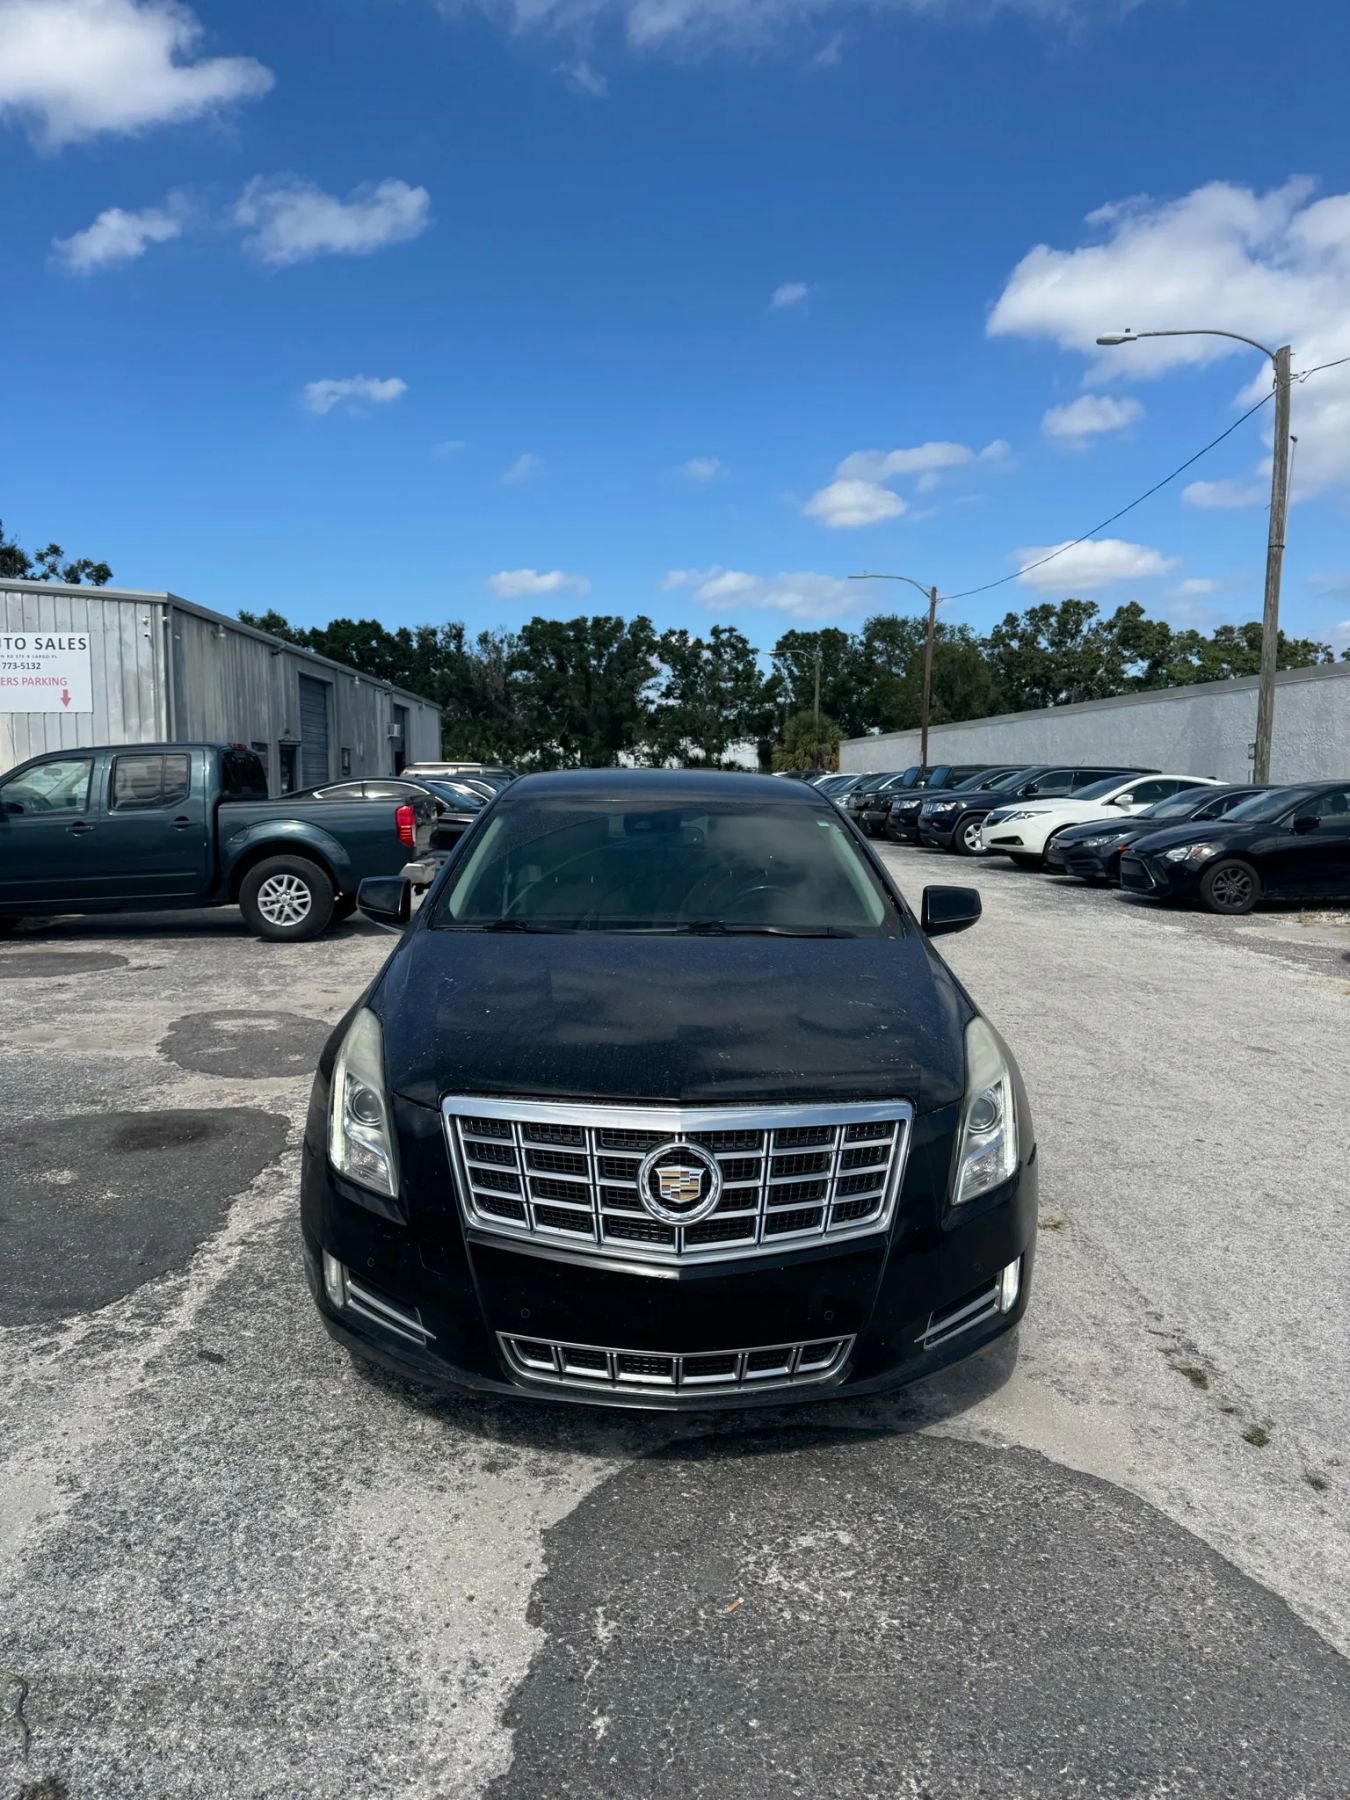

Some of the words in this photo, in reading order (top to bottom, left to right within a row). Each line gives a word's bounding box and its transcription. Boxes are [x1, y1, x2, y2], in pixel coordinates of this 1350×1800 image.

[0, 637, 27, 651] TO
[34, 637, 87, 651] SALES
[2, 662, 41, 670] 773-5132
[0, 677, 19, 686] ERS
[21, 677, 68, 686] PARKING
